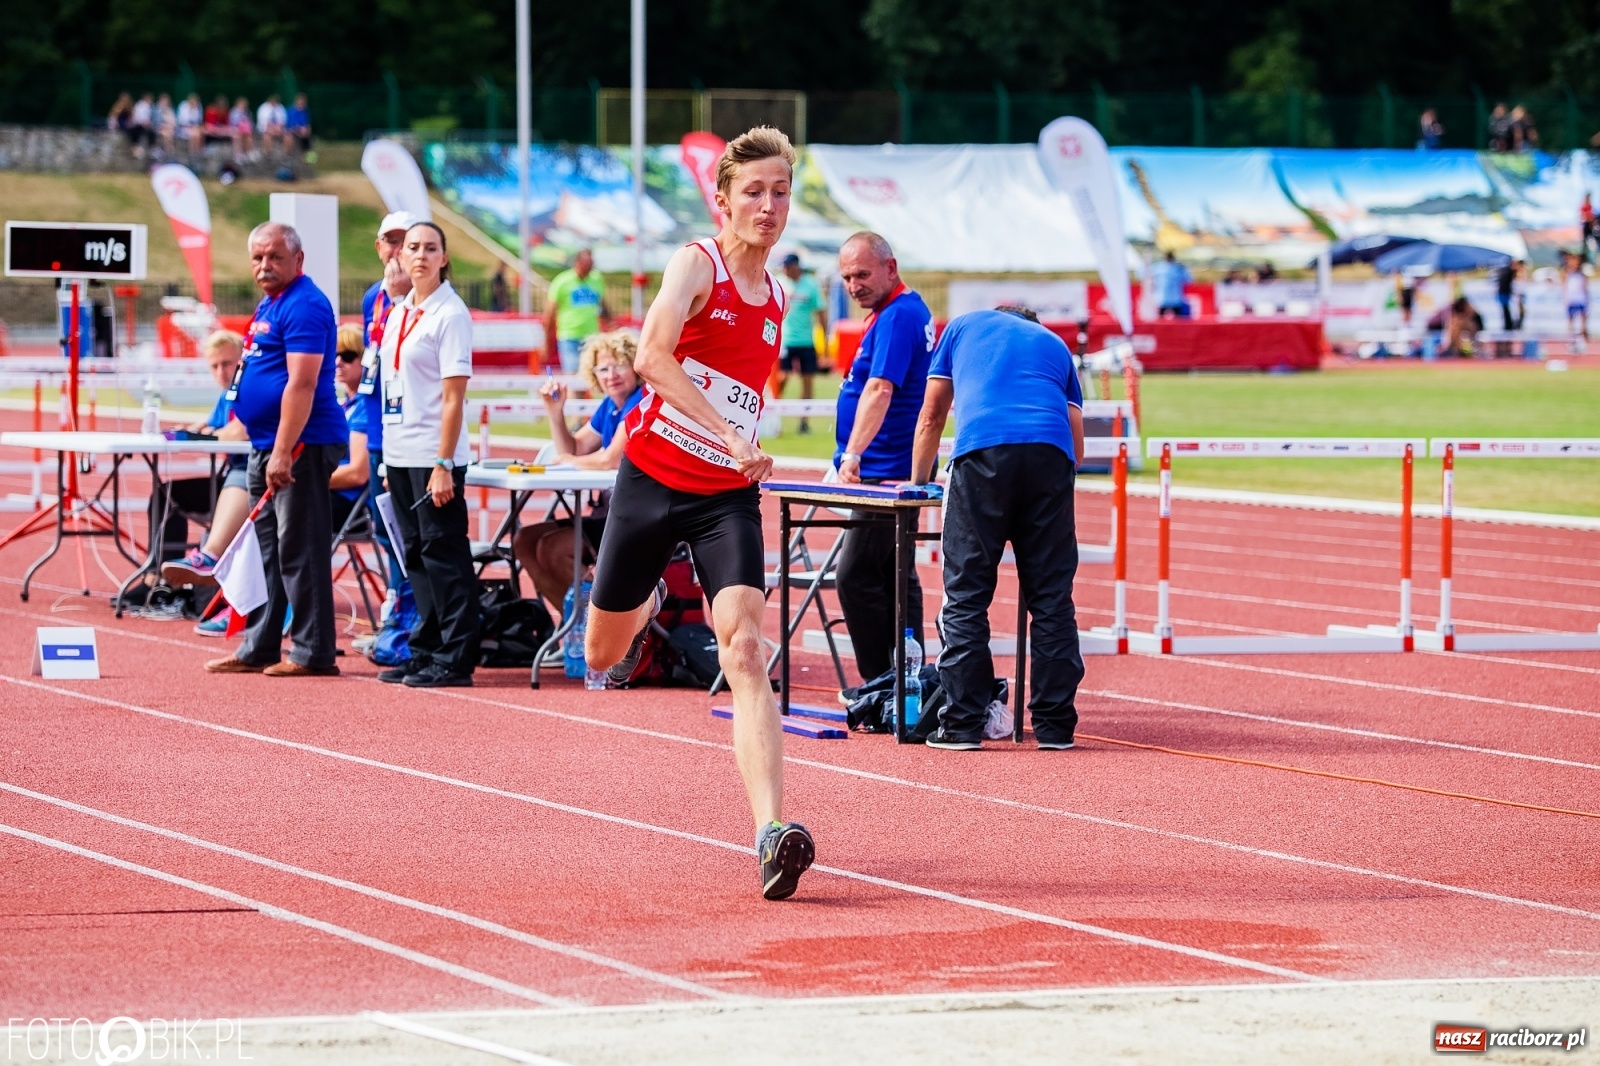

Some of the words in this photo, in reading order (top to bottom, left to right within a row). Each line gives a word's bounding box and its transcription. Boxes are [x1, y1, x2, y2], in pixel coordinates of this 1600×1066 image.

[85, 237, 127, 266] m/s
[727, 385, 758, 414] 318
[661, 427, 708, 457] RACIBÓRZ
[708, 452, 731, 466] 2019
